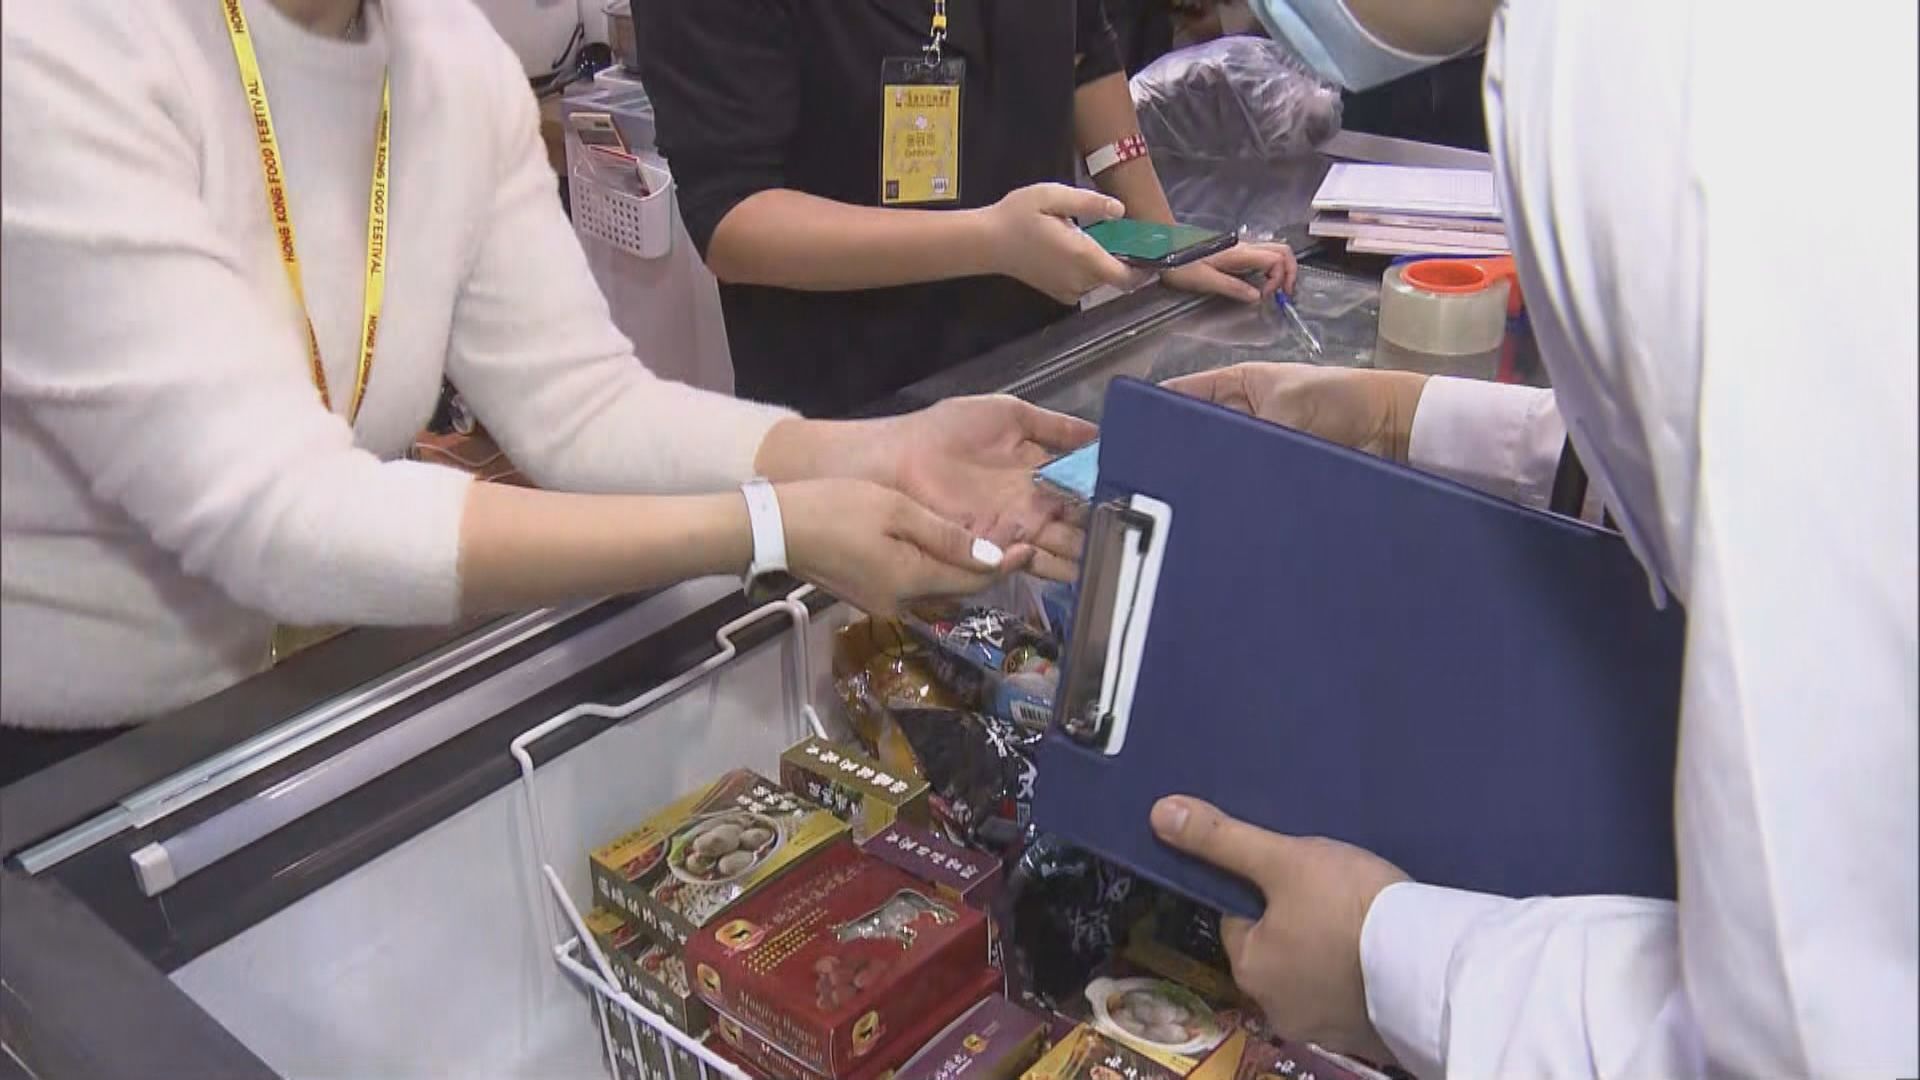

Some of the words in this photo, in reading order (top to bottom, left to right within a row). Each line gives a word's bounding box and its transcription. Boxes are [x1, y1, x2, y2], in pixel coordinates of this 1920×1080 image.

[248, 80, 272, 143] FESTIVAL
[262, 148, 281, 184] FOOD
[270, 187, 288, 223] KONG
[374, 183, 385, 215] FOOD
[279, 227, 294, 263] HONG
[370, 219, 384, 277] FESTIVAL
[366, 315, 377, 348] HONG
